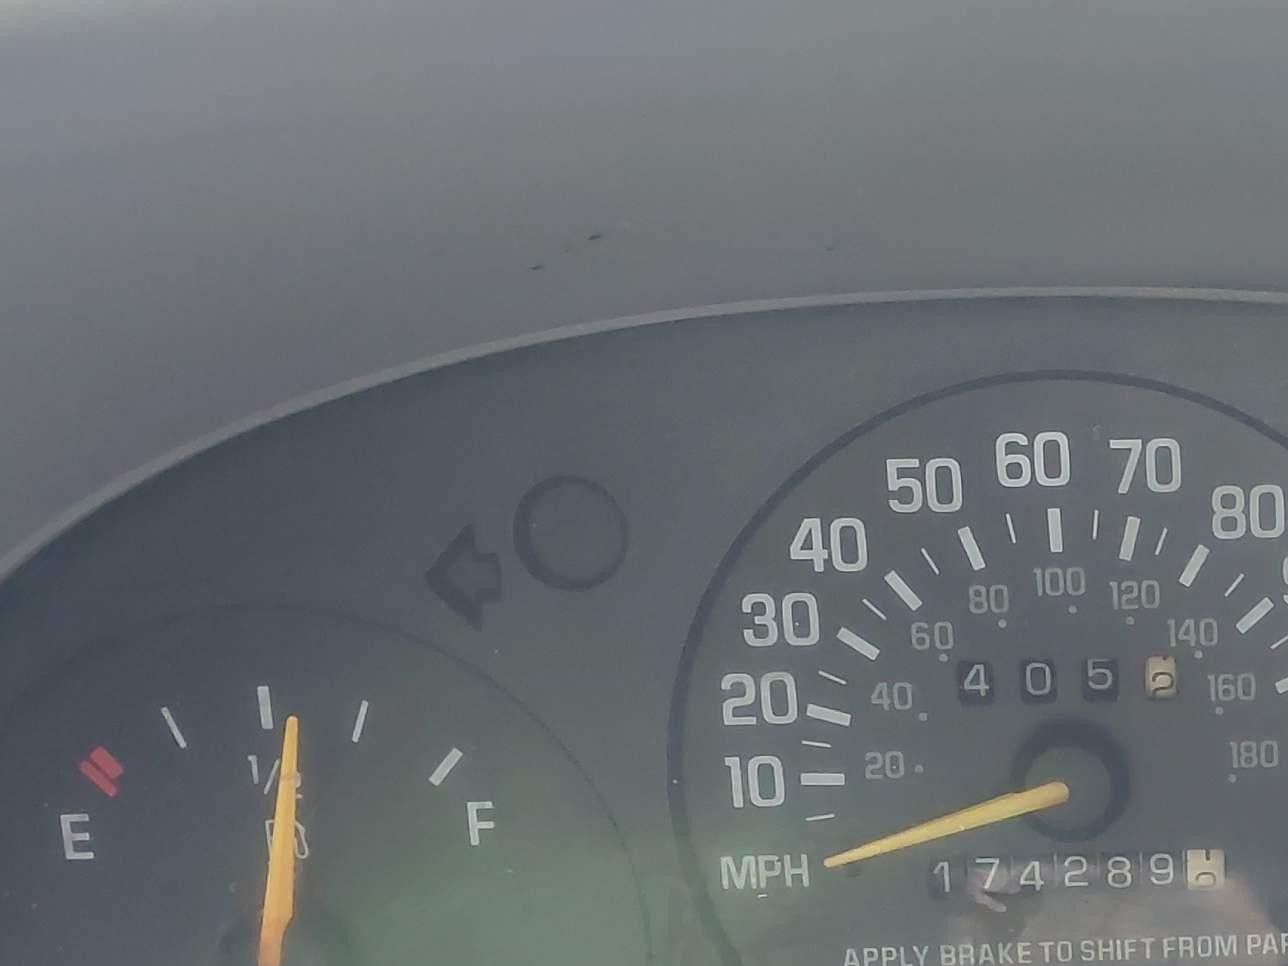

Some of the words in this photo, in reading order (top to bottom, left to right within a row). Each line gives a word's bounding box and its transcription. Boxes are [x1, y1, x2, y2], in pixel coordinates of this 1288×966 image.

[994, 431, 1071, 487] 60
[1109, 438, 1182, 494] 70
[885, 458, 963, 513] 50
[1211, 484, 1286, 539] 80
[789, 518, 868, 572] 40
[967, 584, 1010, 614] 80
[1033, 567, 1086, 597] 100
[1109, 580, 1161, 610] 120
[741, 592, 820, 647] 30
[910, 621, 954, 650] 60
[1167, 618, 1219, 647] 140
[720, 671, 798, 726] 20
[870, 682, 914, 711] 40
[1207, 673, 1257, 701] 160
[864, 750, 905, 780] 20
[1229, 740, 1279, 769] 180
[724, 755, 786, 808] 10
[60, 813, 94, 860] E
[466, 800, 495, 846] F
[720, 854, 810, 890] MPH
[940, 941, 1032, 966] BRAKE
[1039, 940, 1073, 962] TO
[1080, 936, 1156, 962] SHIFT
[1162, 934, 1238, 958] FROM
